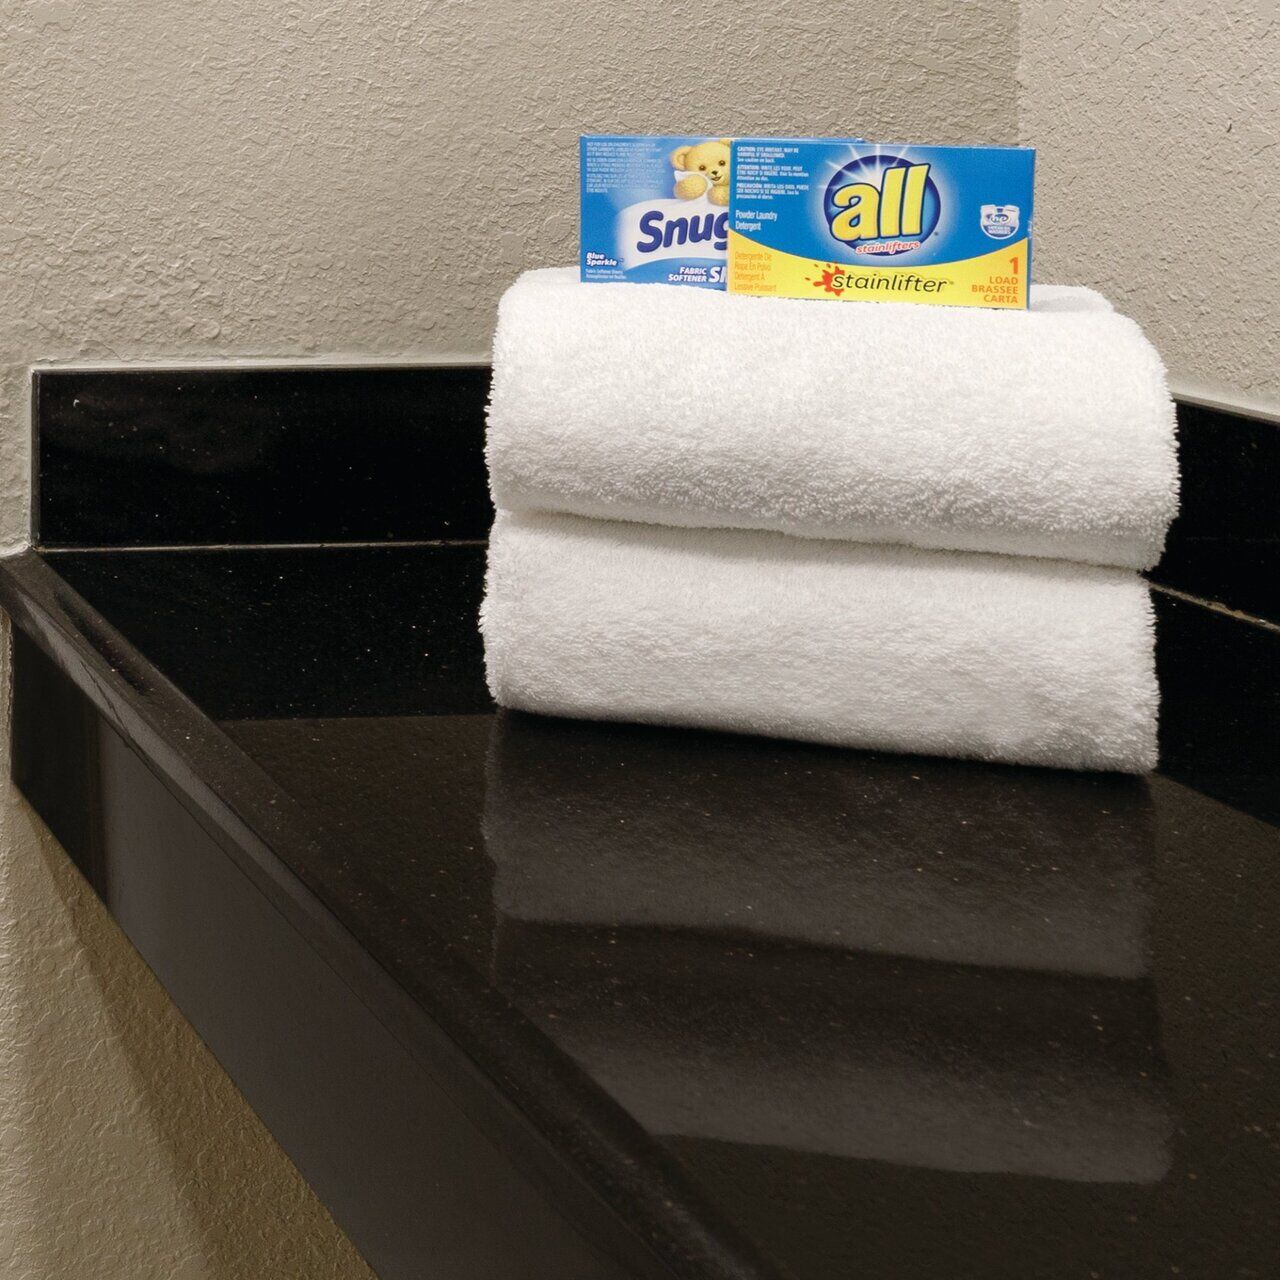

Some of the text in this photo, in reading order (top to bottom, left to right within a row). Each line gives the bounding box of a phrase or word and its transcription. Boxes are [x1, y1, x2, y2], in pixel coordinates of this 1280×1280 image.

[830, 163, 931, 242] all
[735, 210, 778, 221] Powder Laundry
[735, 221, 762, 232] Detergent
[856, 240, 920, 254] stainlifters
[586, 252, 605, 260] Blue
[586, 258, 618, 267] Sparkle
[1009, 256, 1019, 275] 1
[679, 267, 707, 275] FABRIC
[668, 273, 707, 282] SOFTENER
[832, 273, 948, 293] stainlifter
[989, 276, 1018, 285] LOAD
[971, 284, 1018, 295] BRASSEE
[983, 294, 1018, 304] CARTA
